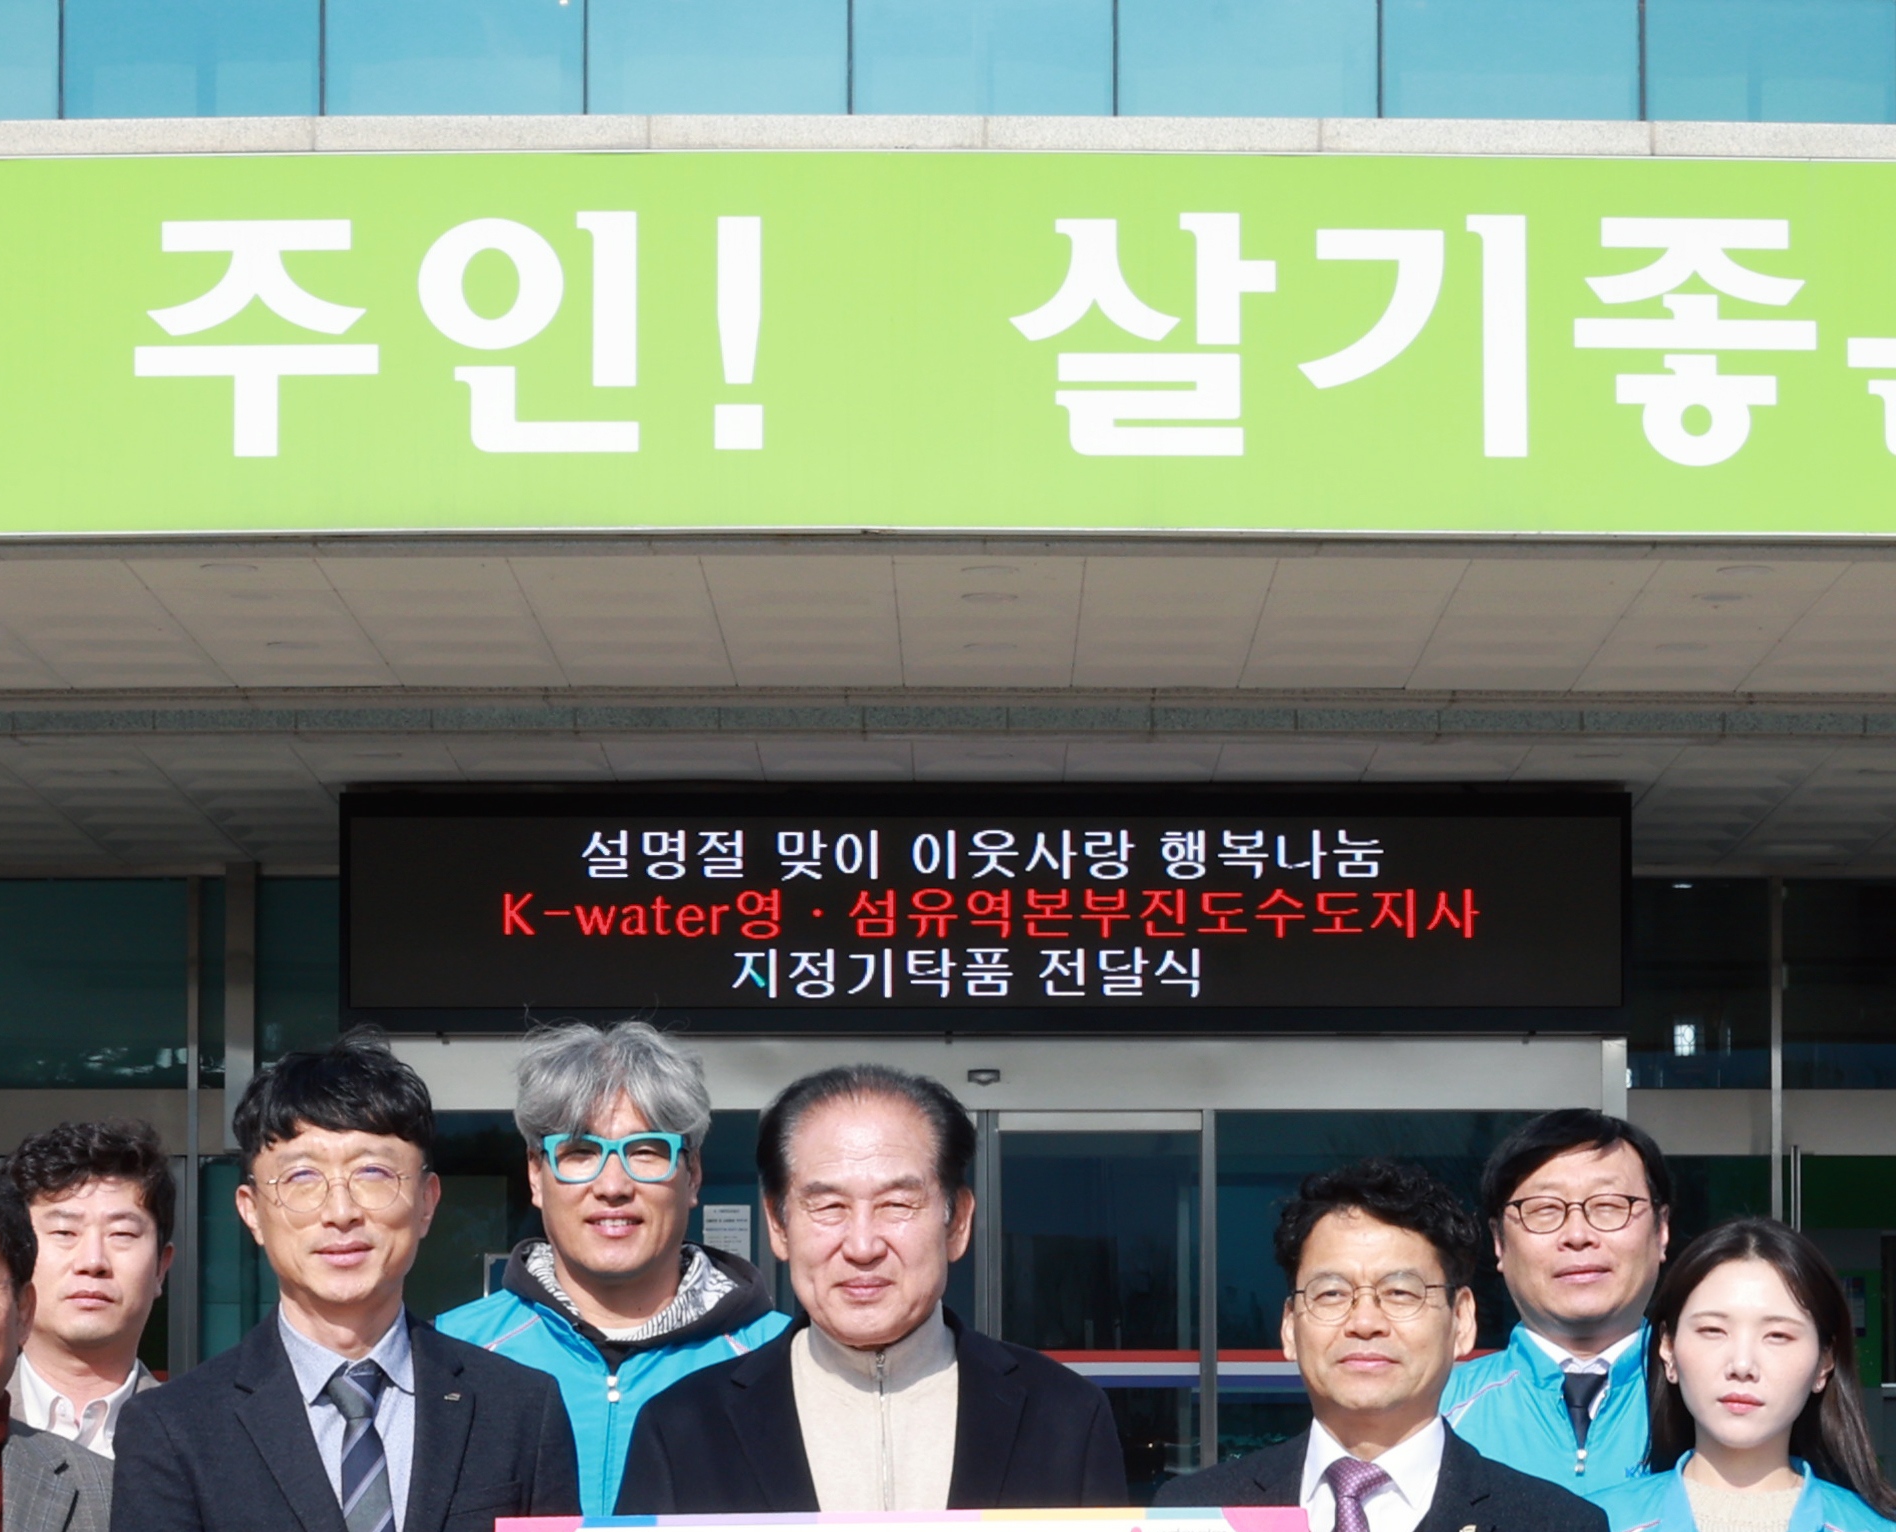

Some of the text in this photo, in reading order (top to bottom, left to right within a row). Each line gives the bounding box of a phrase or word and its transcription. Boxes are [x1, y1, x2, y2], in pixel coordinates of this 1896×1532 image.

[134, 211, 764, 457] 주인!
[582, 830, 1383, 881] 설명절 맞이 이웃사랑 행복나눔
[732, 947, 1202, 998] 지정기탁품 전달식
